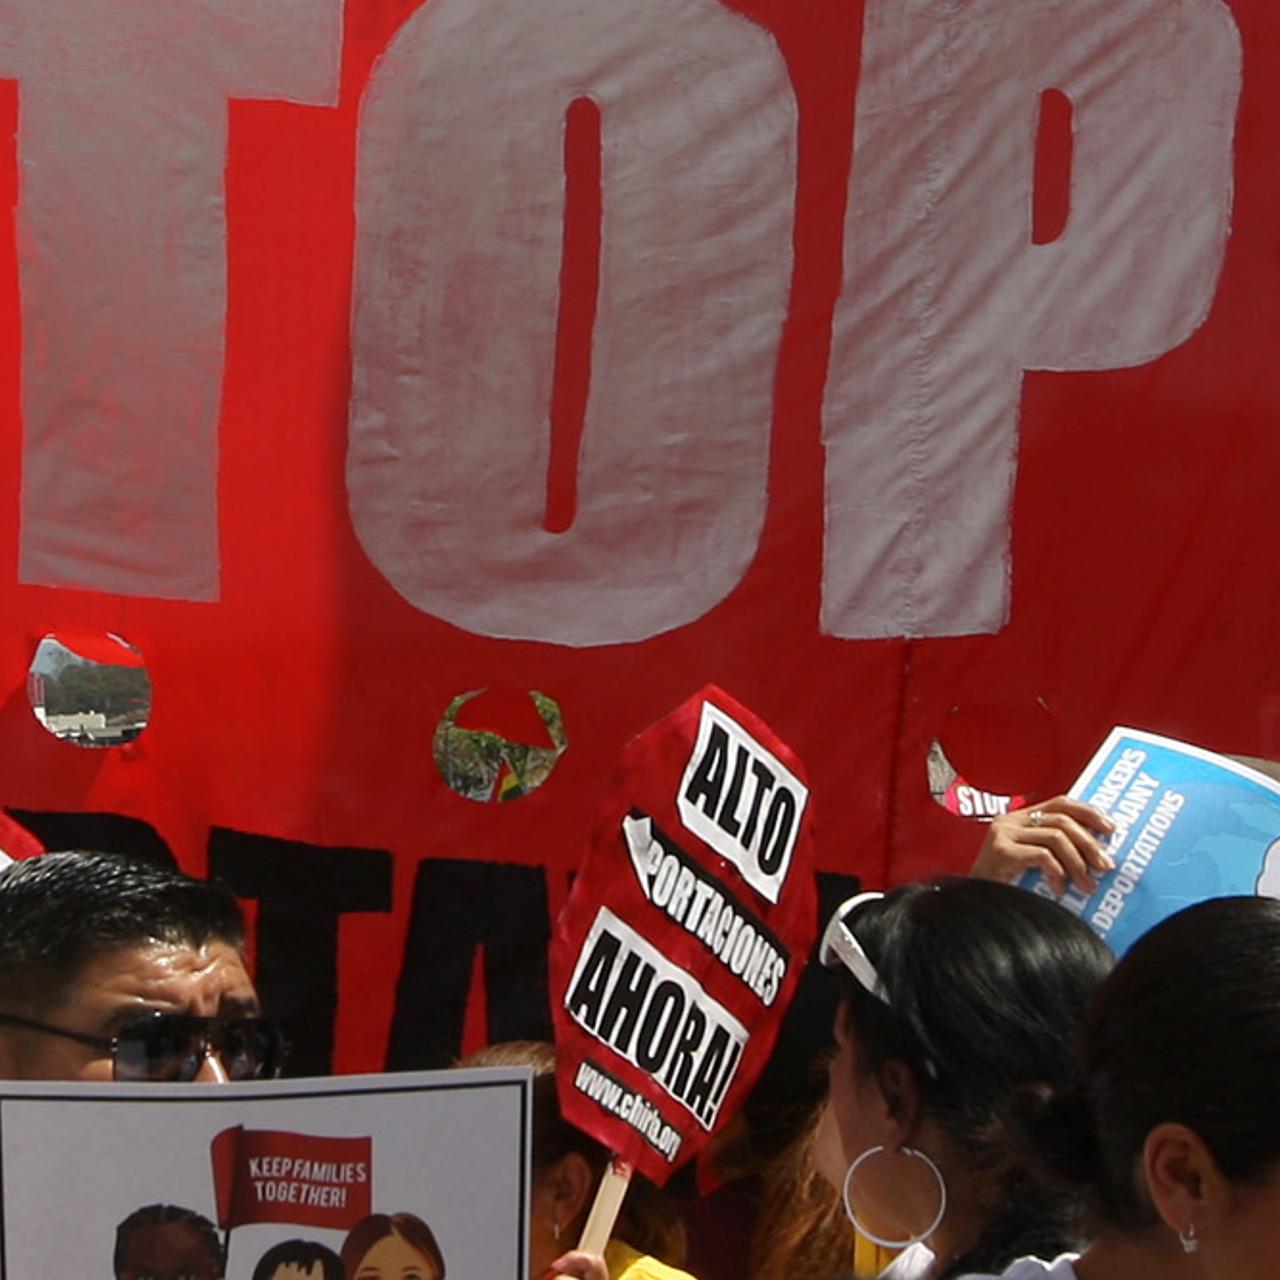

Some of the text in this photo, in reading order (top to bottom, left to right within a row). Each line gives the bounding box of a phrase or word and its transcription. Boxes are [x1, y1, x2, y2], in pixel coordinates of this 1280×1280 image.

[684, 724, 797, 876] ALTO
[1092, 789, 1186, 931] DEPORTATIONS
[647, 843, 787, 1007] PORTACIONES
[568, 929, 744, 1122] AHORA!
[249, 1156, 367, 1183] KEEP FAMILIES
[254, 1180, 347, 1208] TOGETHER!
